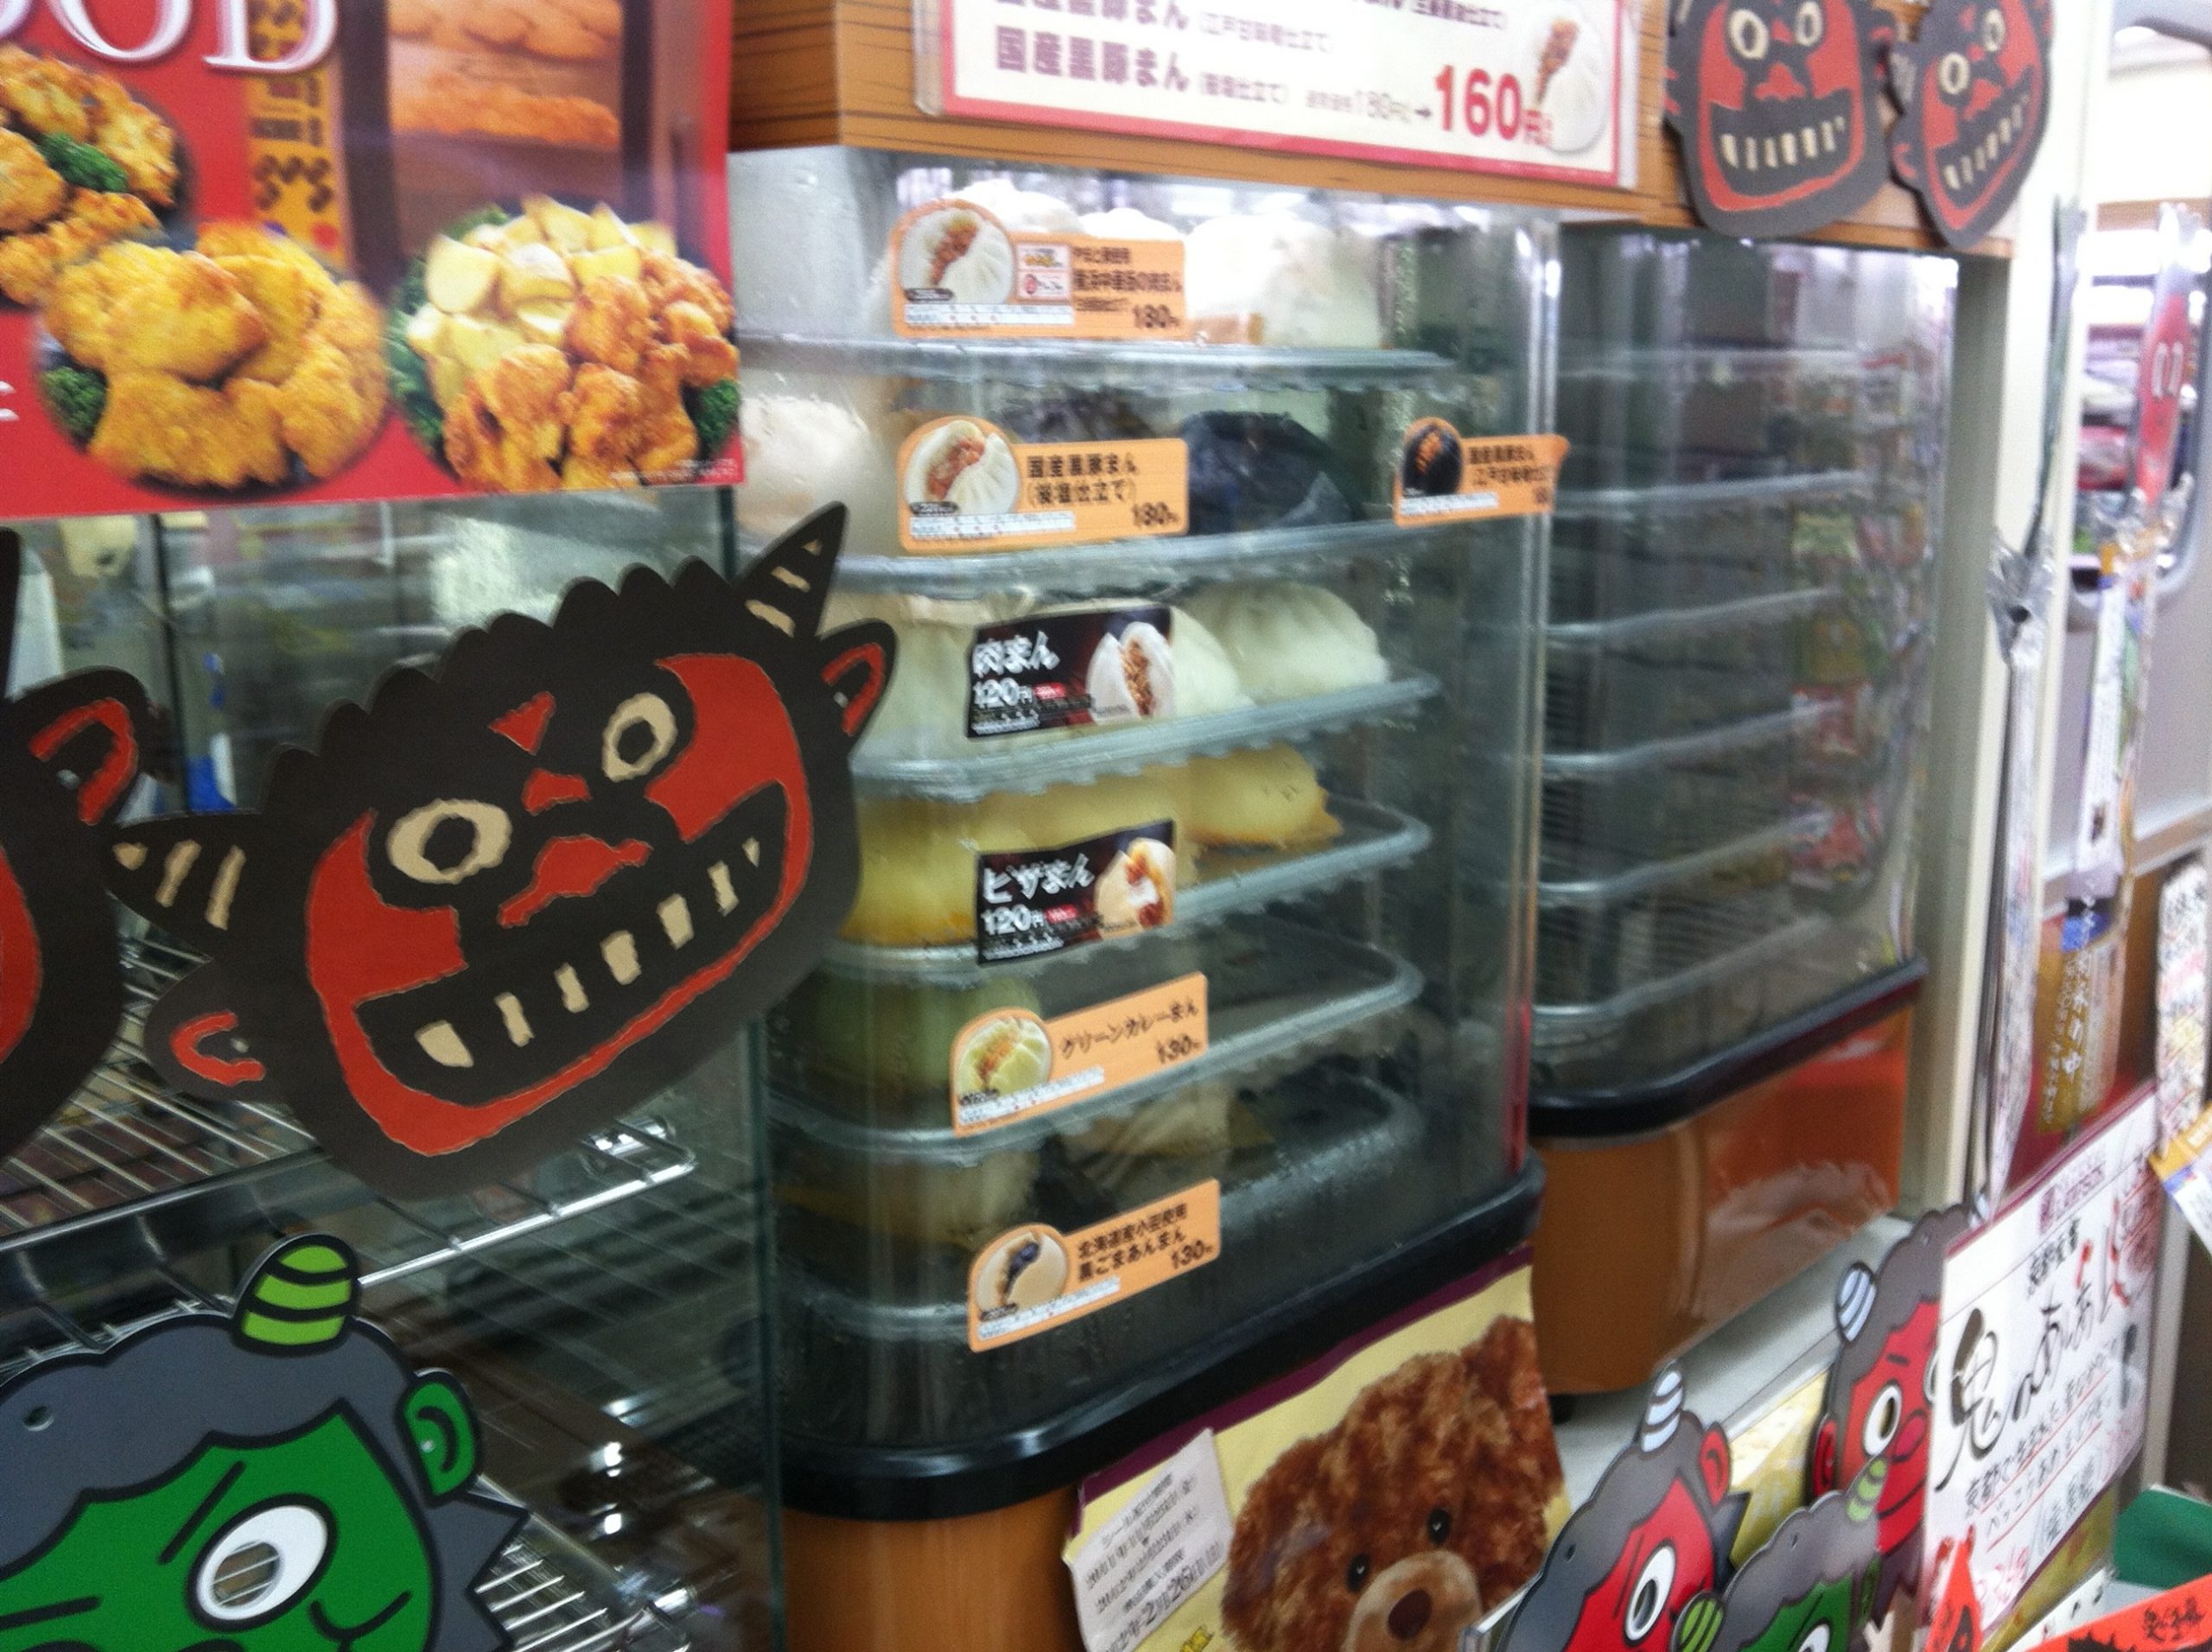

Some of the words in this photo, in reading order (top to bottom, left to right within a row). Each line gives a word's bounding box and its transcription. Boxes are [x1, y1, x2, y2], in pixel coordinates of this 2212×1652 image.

[996, 25, 1191, 92] 国産黒豚まん
[1028, 452, 1137, 478] 国産黒豚まん
[971, 630, 1061, 678] 肉まん
[983, 851, 1096, 905] ピザまん
